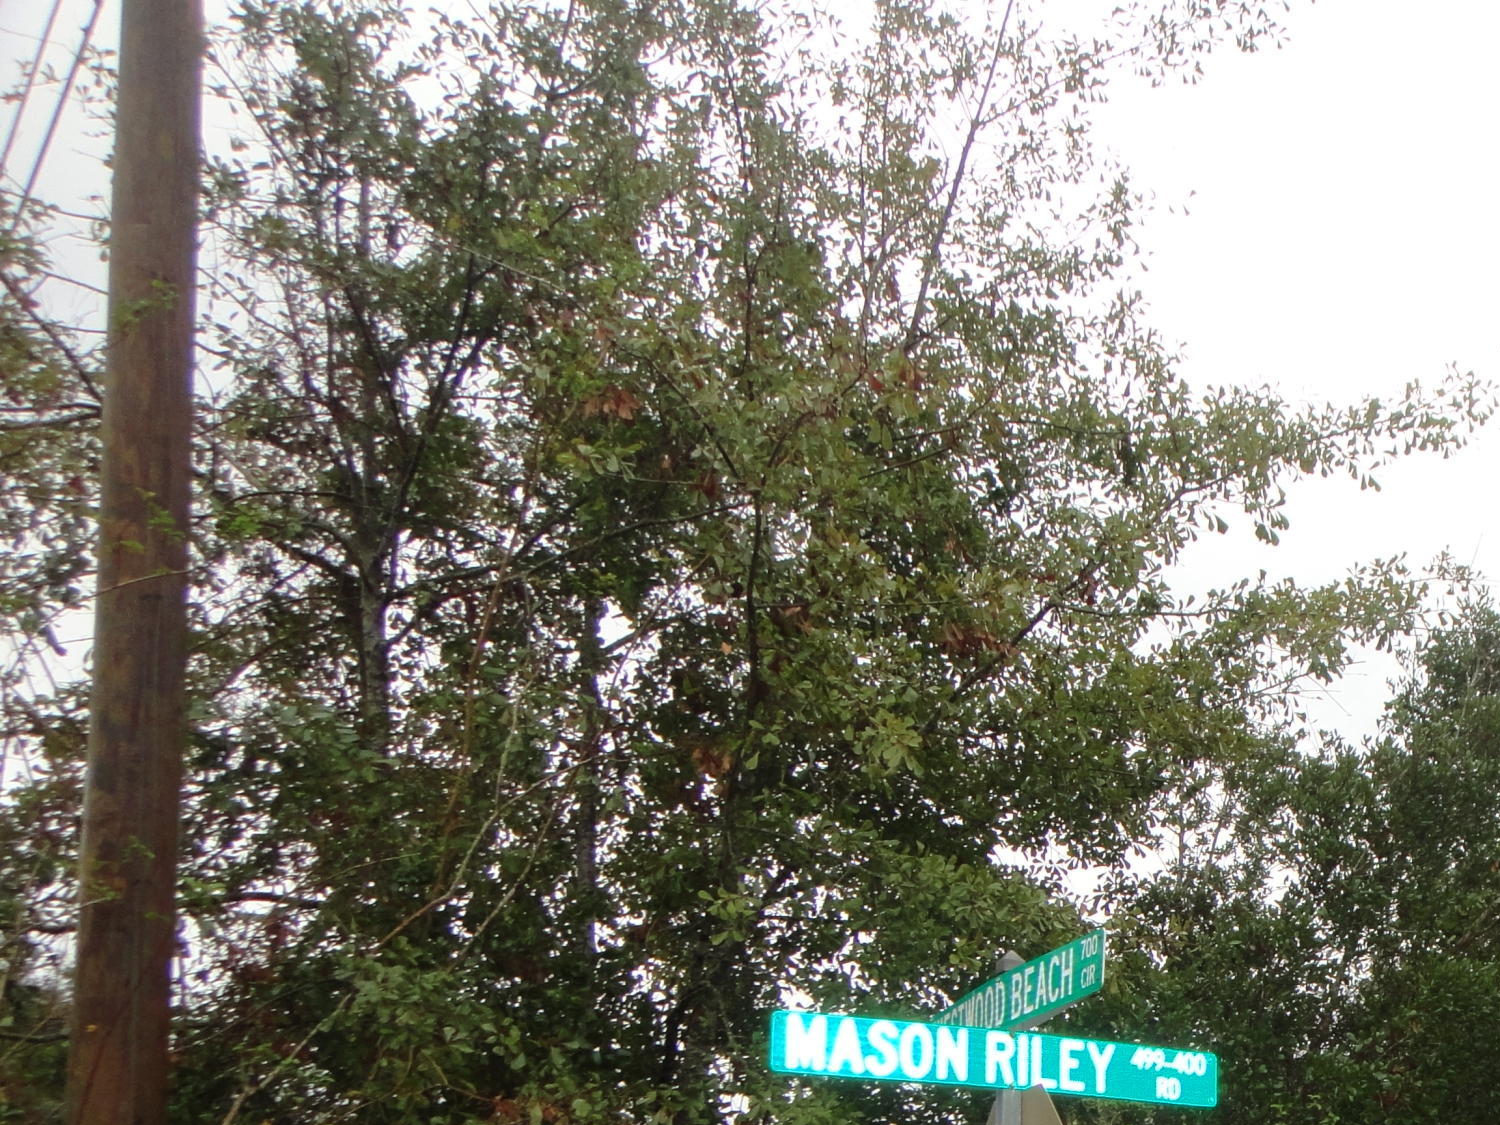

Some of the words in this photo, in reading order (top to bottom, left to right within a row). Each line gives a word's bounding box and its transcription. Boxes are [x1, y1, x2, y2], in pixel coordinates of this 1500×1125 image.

[1081, 935, 1097, 960] 700
[934, 980, 1005, 1029] TWOOD
[1011, 948, 1073, 1020] BEACH
[1081, 964, 1096, 988] CIR
[785, 1012, 969, 1082] MASON
[985, 1030, 1116, 1094] RILEY
[1130, 1046, 1207, 1076] 499-400
[1156, 1076, 1181, 1100] RD
